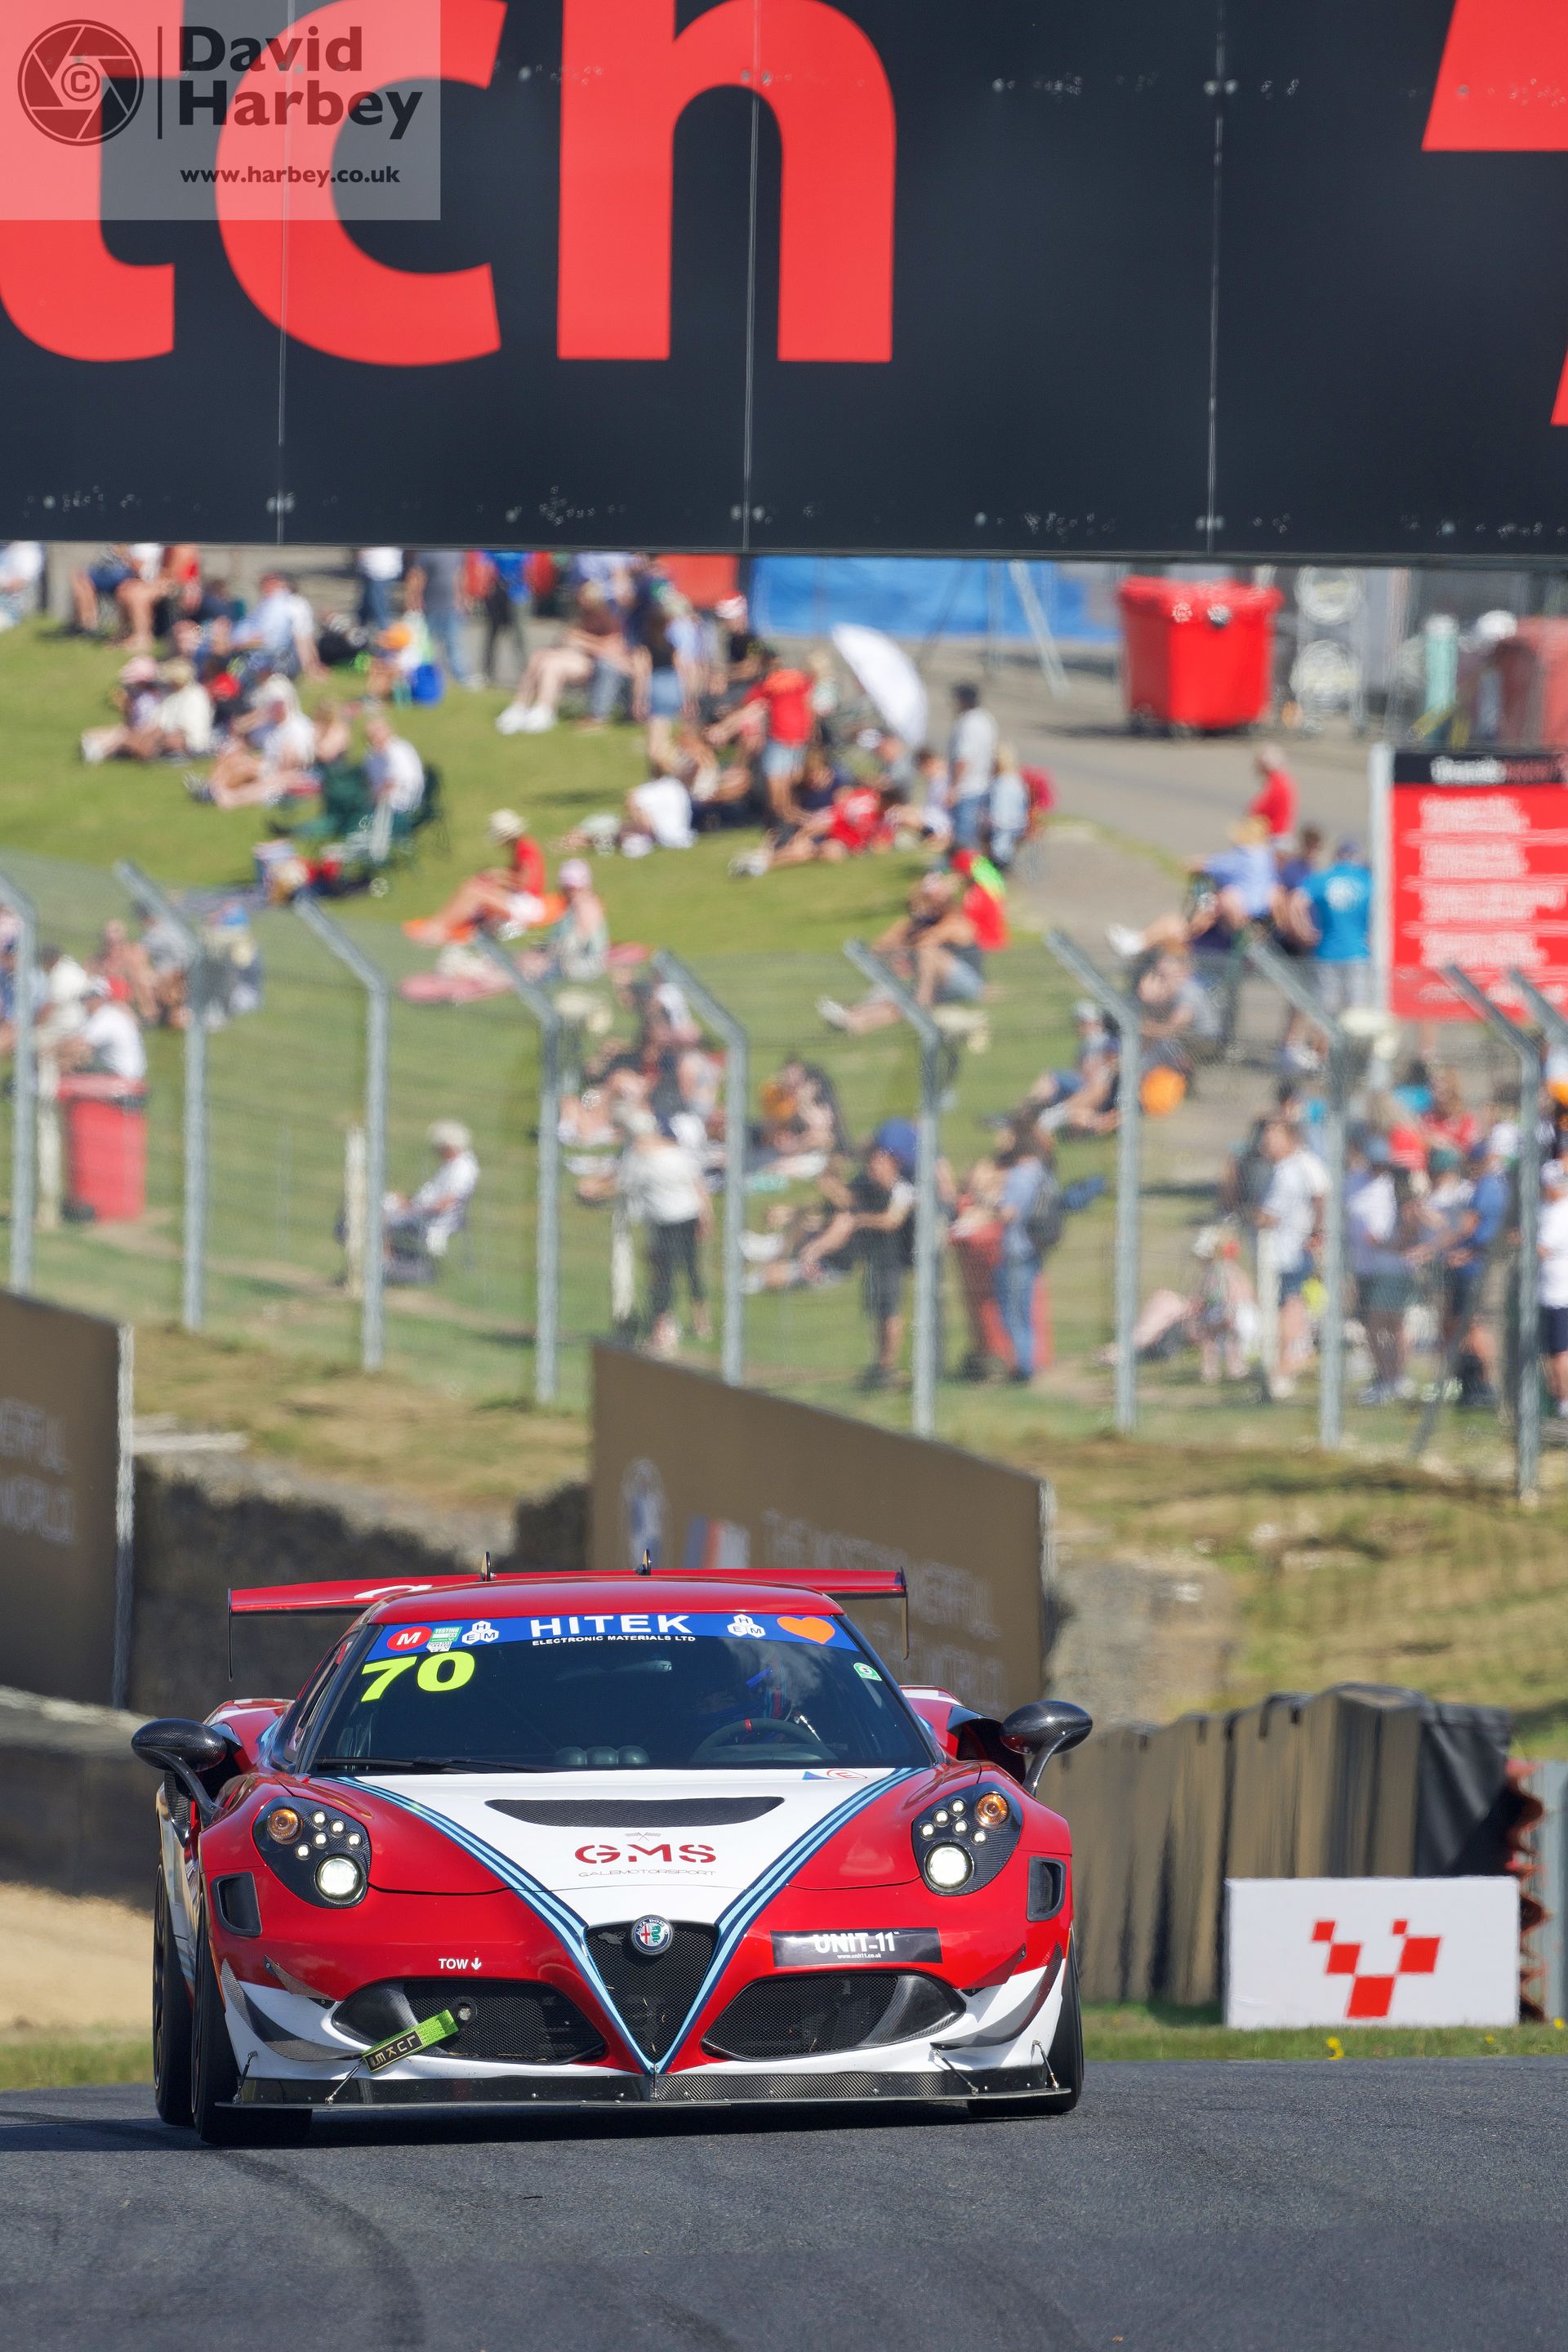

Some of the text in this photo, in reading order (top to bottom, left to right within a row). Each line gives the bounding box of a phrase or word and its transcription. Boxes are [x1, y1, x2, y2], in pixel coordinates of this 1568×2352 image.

[531, 1615, 693, 1637] HITEK
[396, 1632, 422, 1646] M
[532, 1636, 604, 1646] ELECTRONIC
[361, 1651, 475, 1702] 70
[574, 1843, 716, 1864] GMS
[578, 1869, 716, 1878] GALEMOTORSPORT
[813, 1931, 896, 1953] UNIT-11
[439, 1958, 469, 1970] TOW
